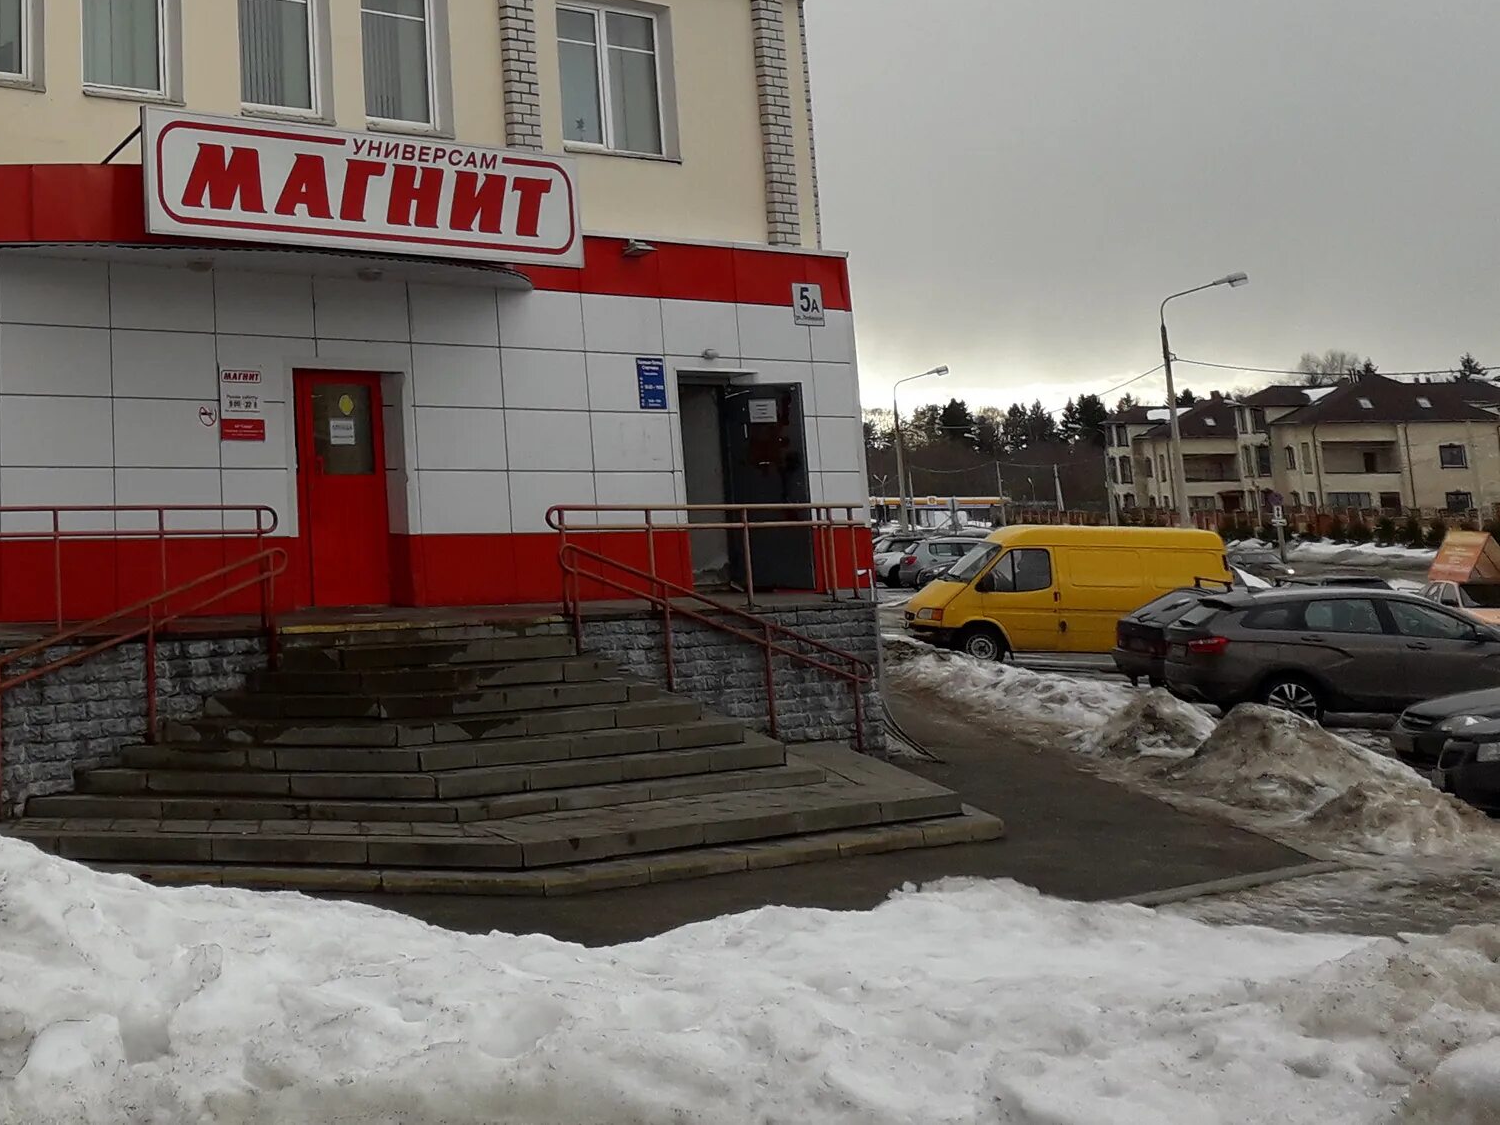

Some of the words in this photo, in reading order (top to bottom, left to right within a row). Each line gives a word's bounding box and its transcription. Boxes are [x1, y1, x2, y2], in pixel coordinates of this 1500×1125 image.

[352, 137, 498, 171] УНИВЕРСАМ
[181, 142, 553, 238] МАГНИТ
[223, 372, 260, 382] МАГНИТ
